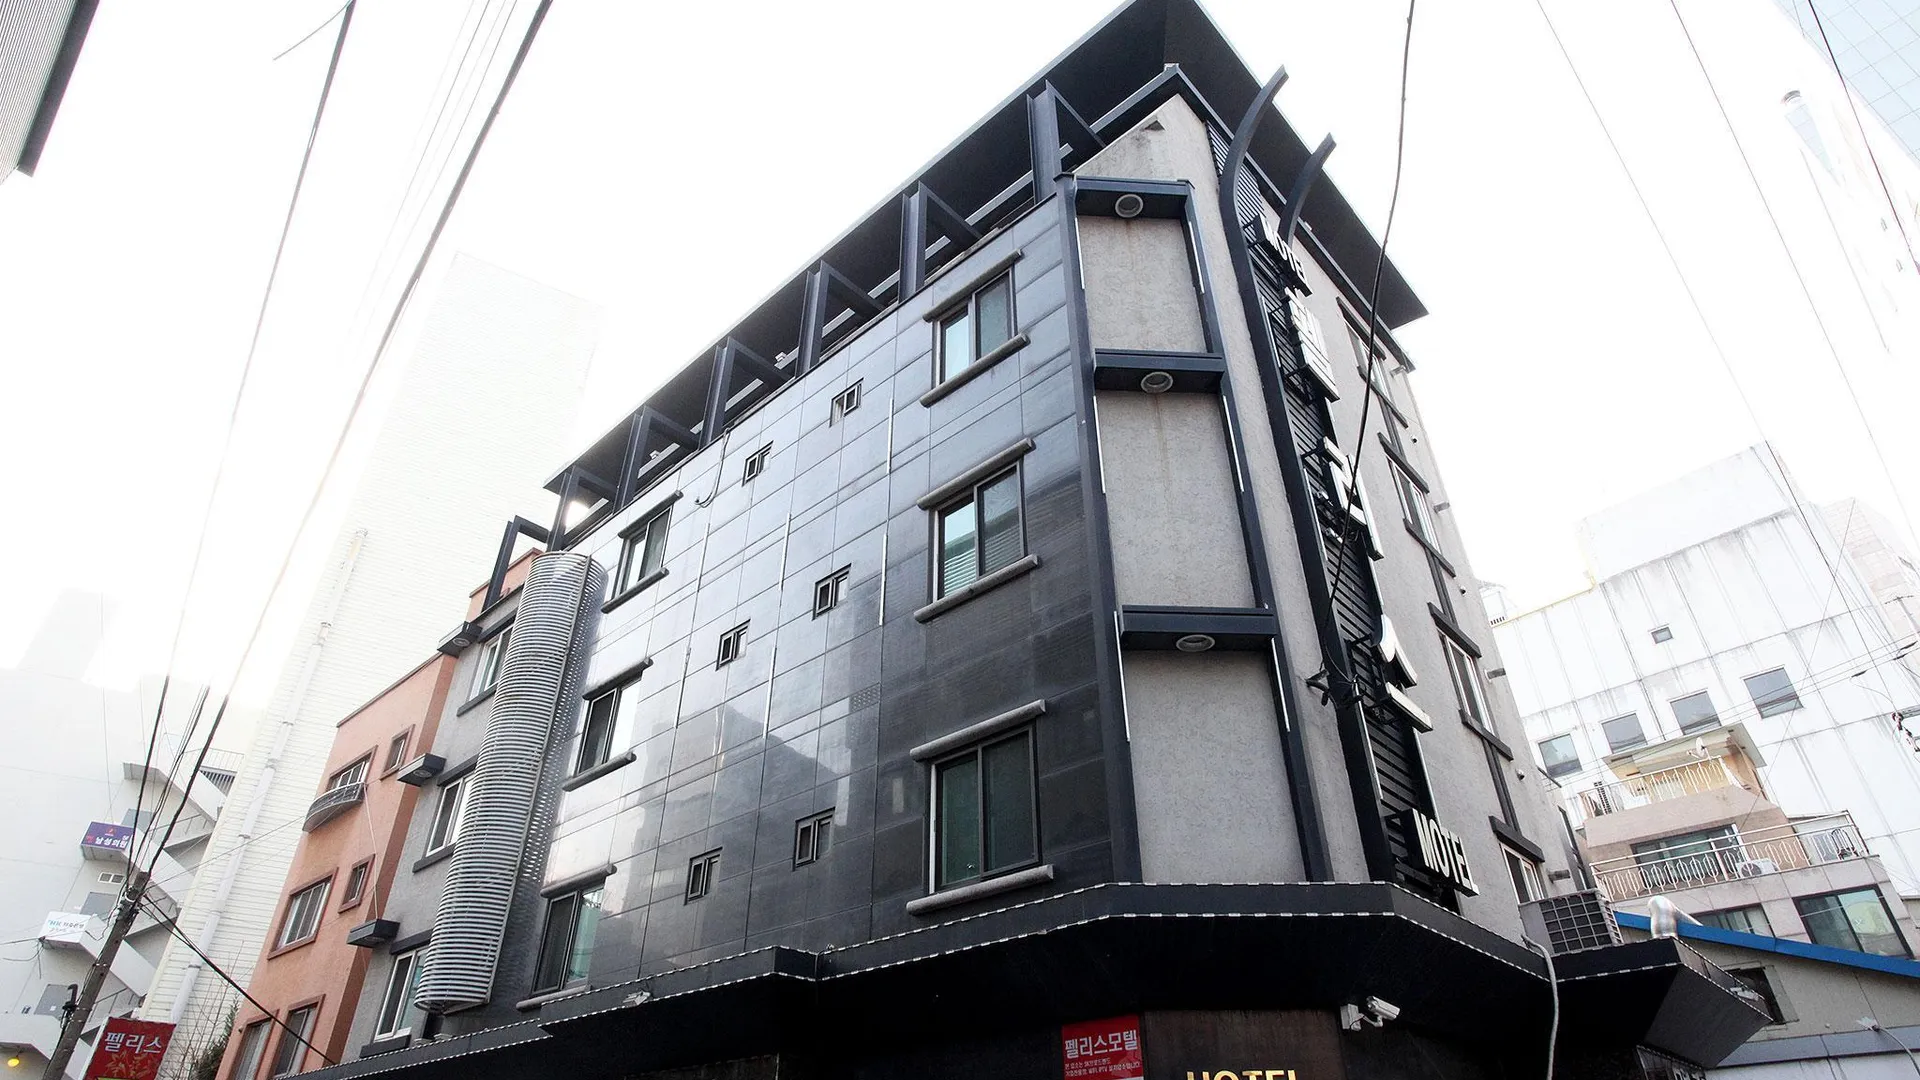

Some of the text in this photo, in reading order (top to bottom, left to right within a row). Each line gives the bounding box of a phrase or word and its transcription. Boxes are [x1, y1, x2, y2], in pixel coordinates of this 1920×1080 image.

[1260, 214, 1312, 296] MOTEL
[1412, 808, 1480, 895] MOTEL
[104, 1032, 162, 1054] 펠리스
[1065, 1029, 1138, 1059] 펠리스모텔
